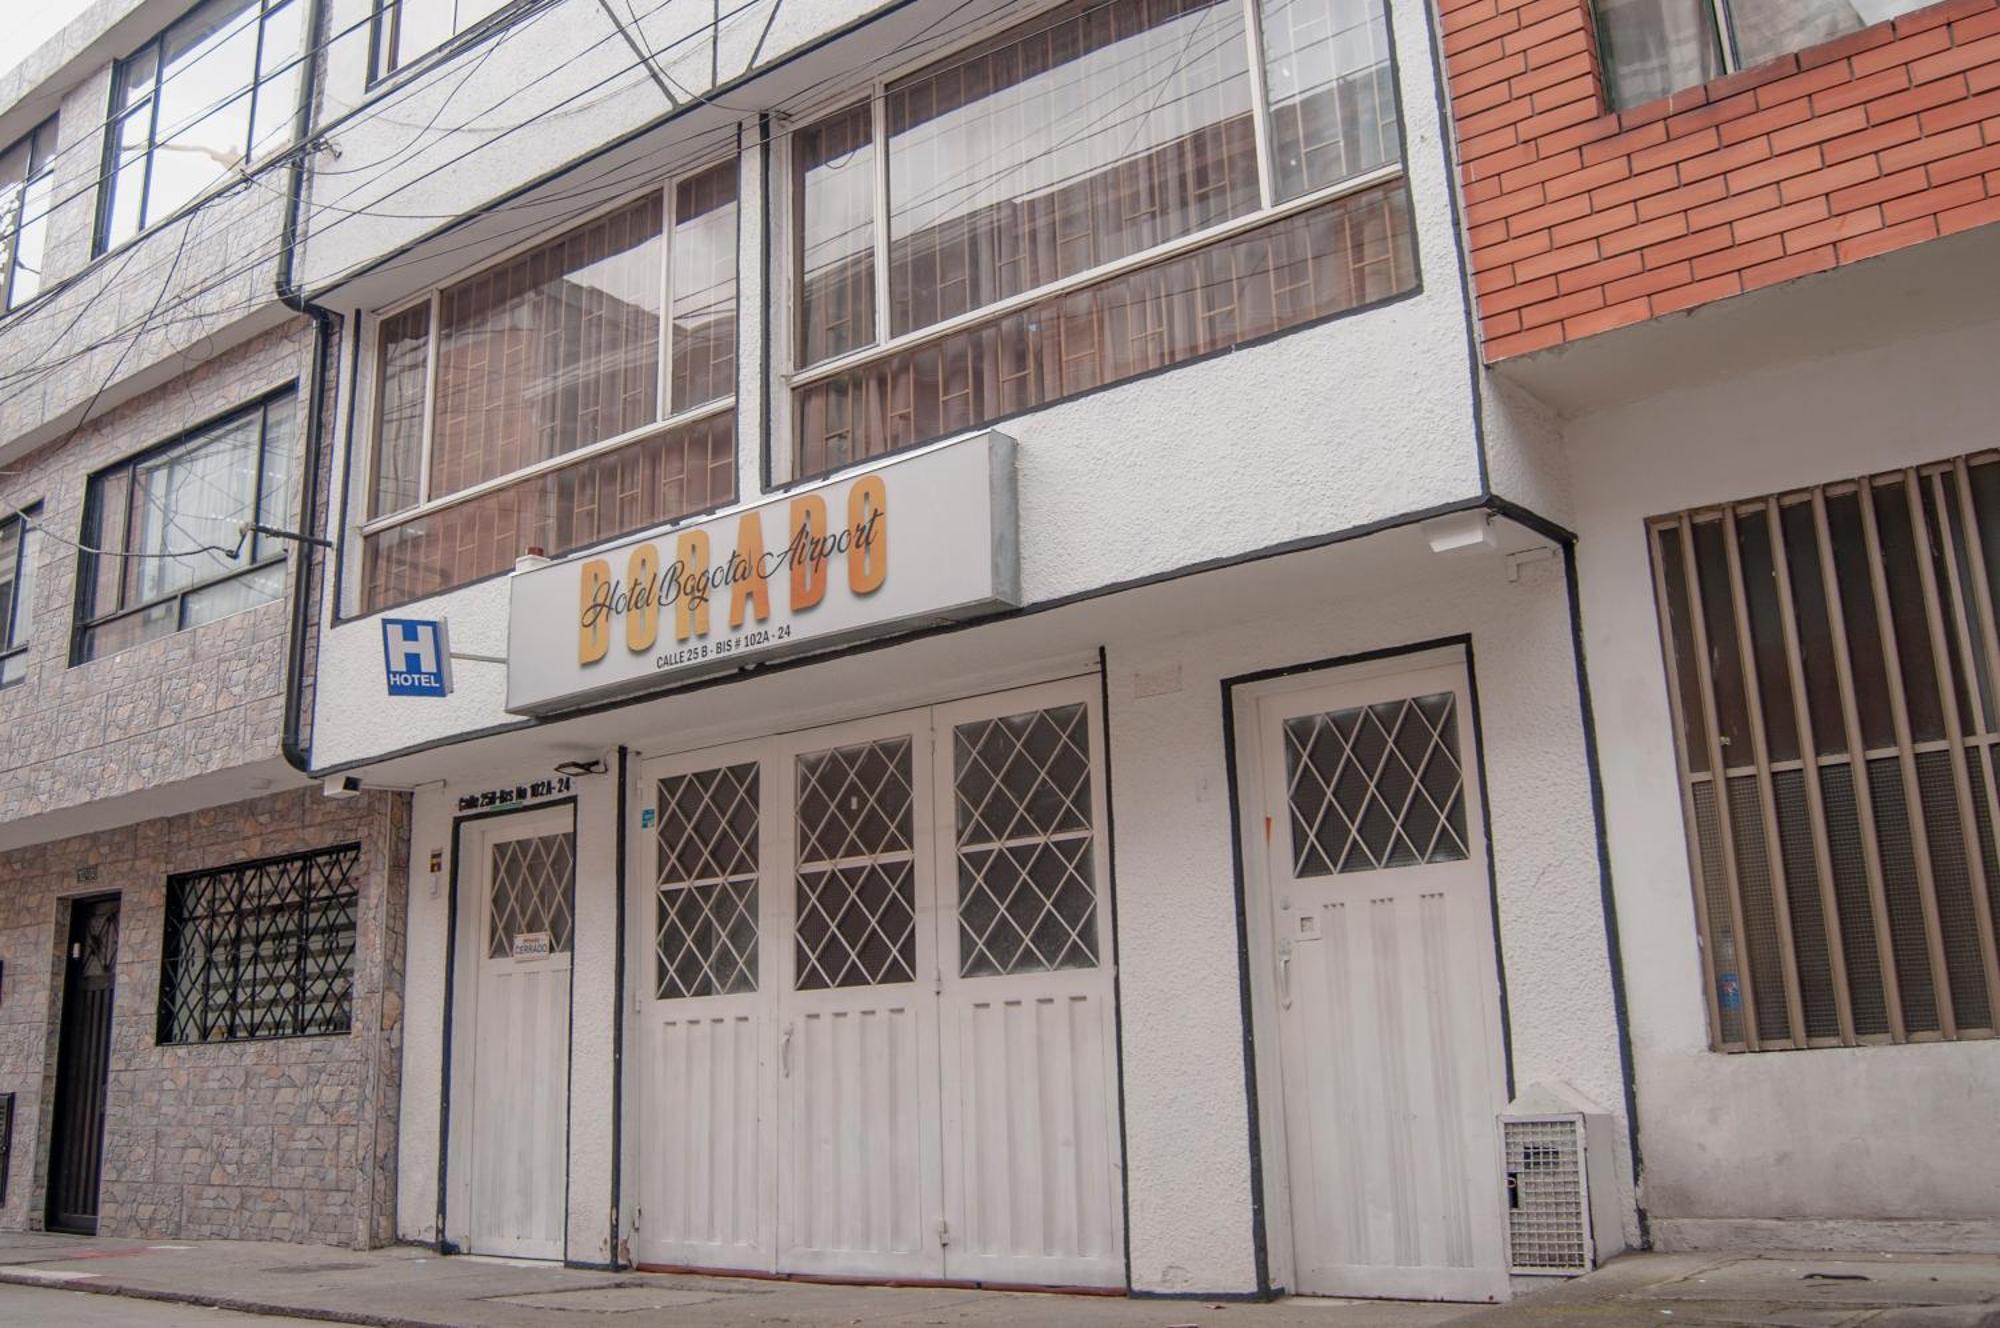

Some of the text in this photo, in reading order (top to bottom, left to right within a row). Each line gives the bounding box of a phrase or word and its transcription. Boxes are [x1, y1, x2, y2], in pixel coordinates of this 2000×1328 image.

[579, 475, 887, 667] DORADO
[581, 575, 656, 628] Hotel
[756, 508, 884, 580] Airport
[386, 624, 438, 672] H
[656, 650, 685, 669] CALLE
[687, 647, 699, 662] 25
[701, 645, 708, 658] B
[715, 639, 733, 655] BIS
[734, 638, 741, 648] #
[744, 630, 770, 648] 102A
[777, 624, 791, 640] 24
[389, 673, 440, 687] HOTEL
